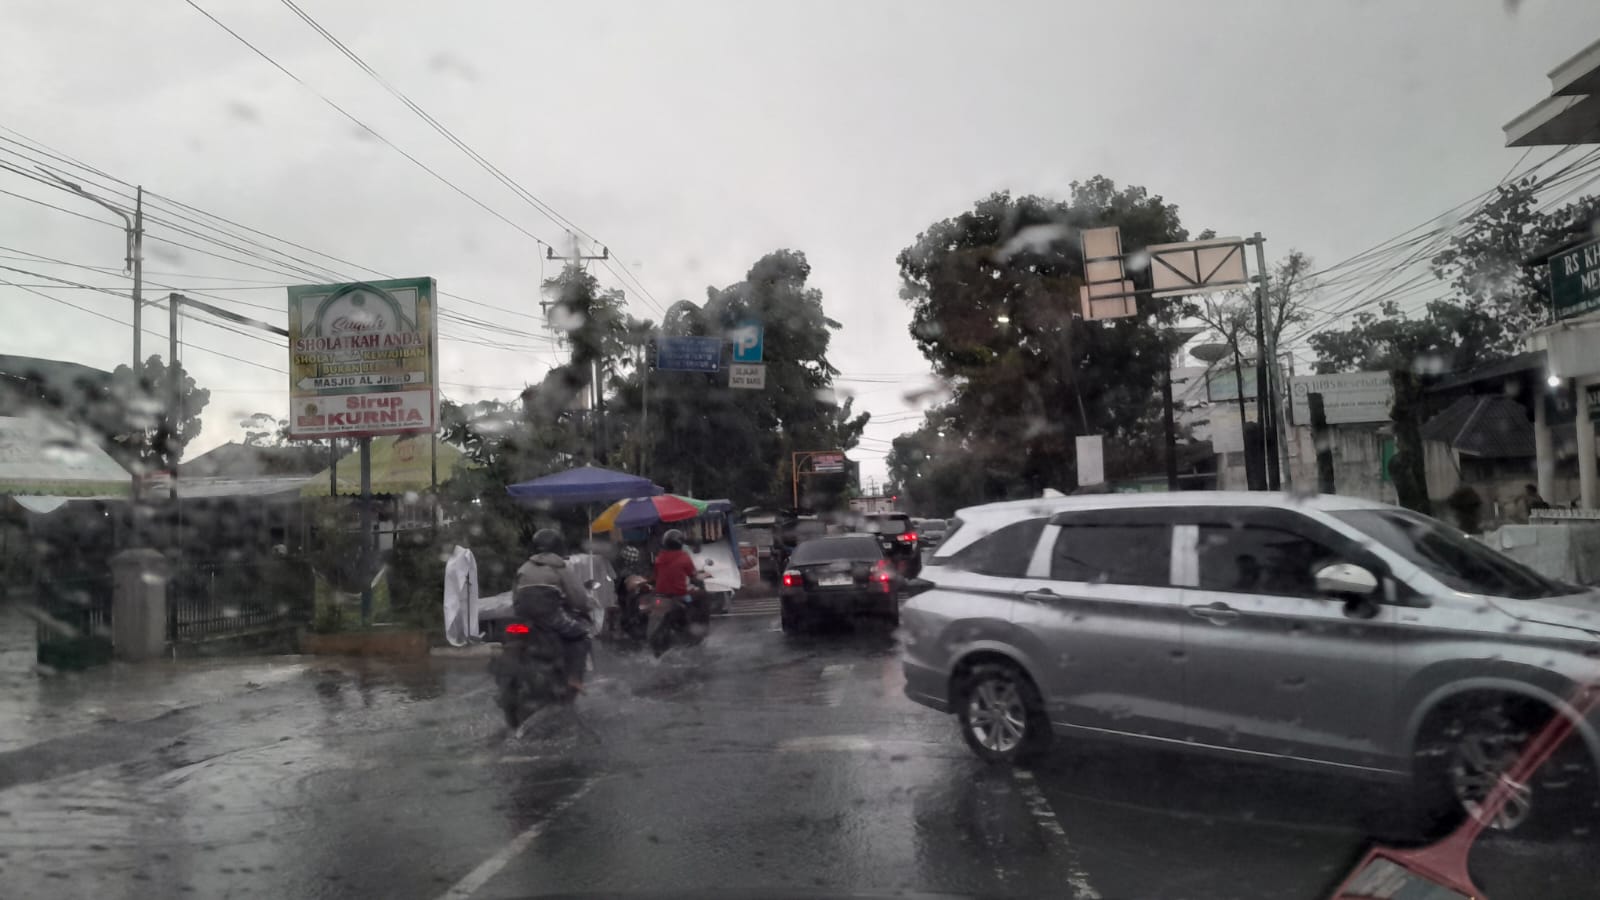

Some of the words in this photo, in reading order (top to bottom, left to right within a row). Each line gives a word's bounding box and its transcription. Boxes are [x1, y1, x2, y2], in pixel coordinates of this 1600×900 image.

[1564, 253, 1580, 276] RS
[1581, 270, 1600, 292] ME
[296, 334, 379, 352] SHOLATKAH
[384, 332, 422, 346] ANDA
[738, 326, 758, 356] P
[313, 376, 356, 388] MASJID
[360, 375, 373, 385] AL
[346, 396, 403, 410] Sirup
[328, 408, 423, 426] KURNIA
